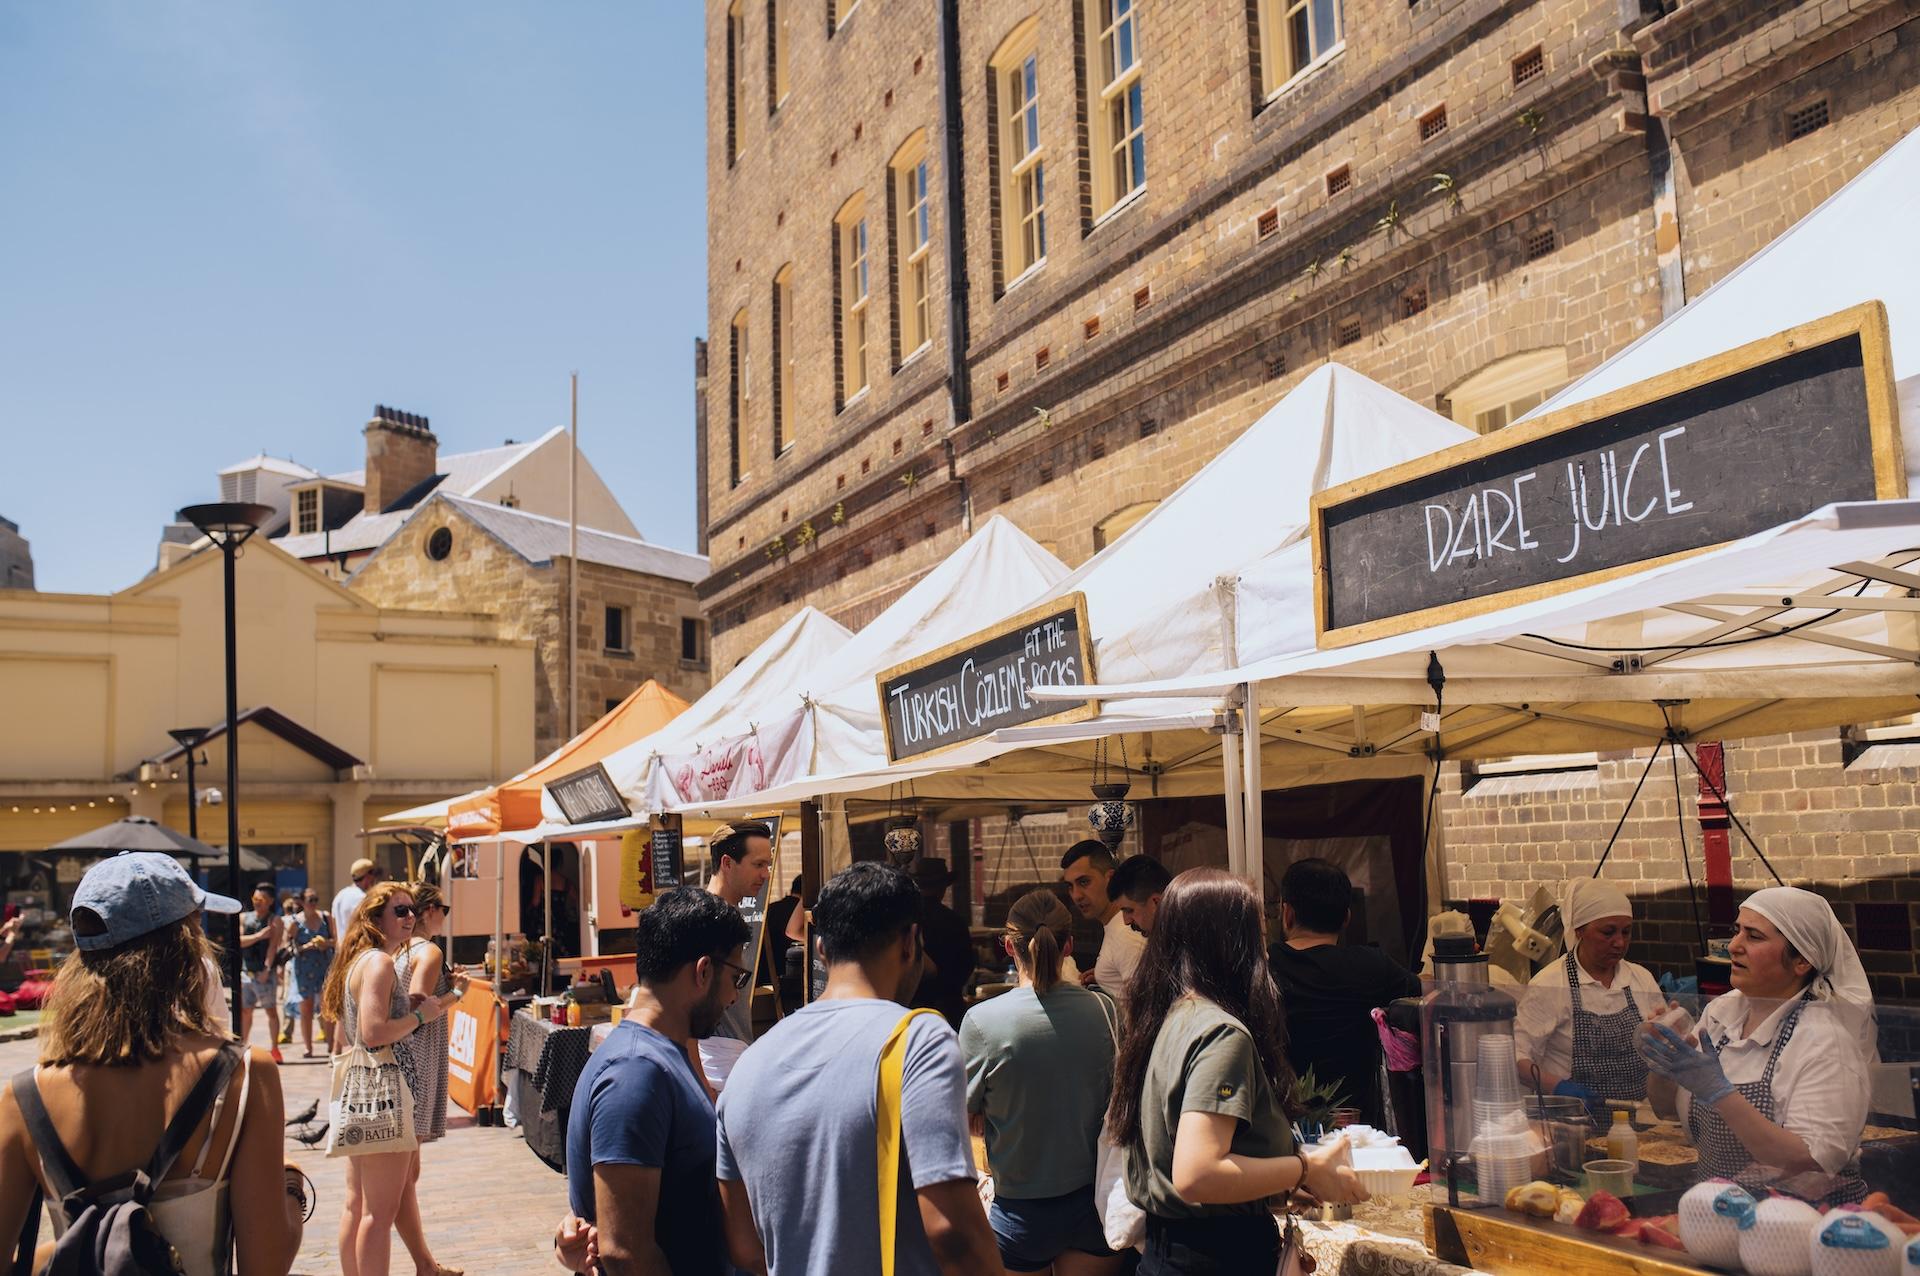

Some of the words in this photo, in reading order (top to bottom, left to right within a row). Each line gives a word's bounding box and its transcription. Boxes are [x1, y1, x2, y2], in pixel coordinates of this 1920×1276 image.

[1424, 472, 1539, 573] DARE
[1557, 426, 1694, 564] JUICE
[1024, 627, 1040, 658] AT
[1043, 618, 1067, 652] THE
[891, 682, 961, 745] TURKISH
[349, 1099, 394, 1113] STUDY
[365, 1127, 395, 1141] BATH
